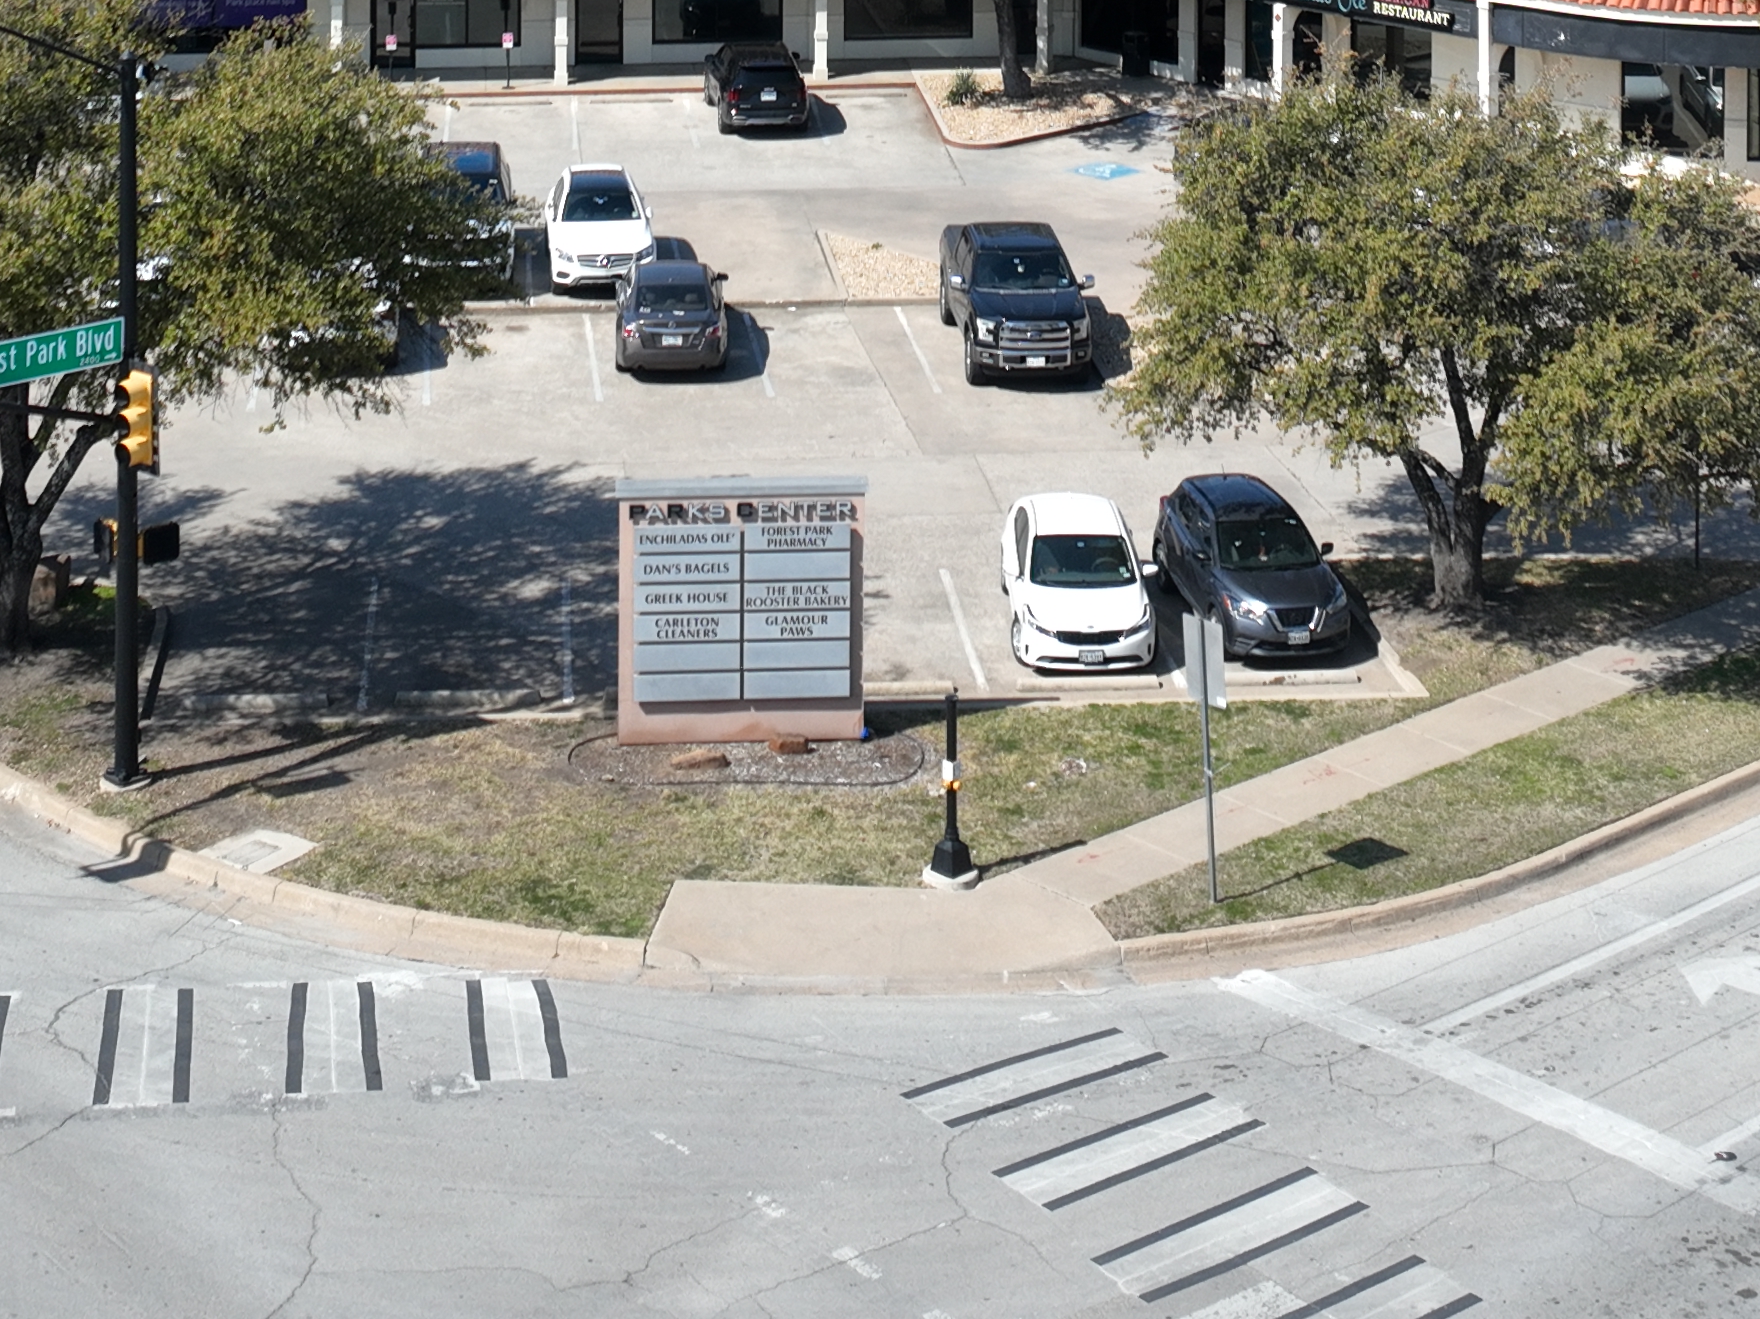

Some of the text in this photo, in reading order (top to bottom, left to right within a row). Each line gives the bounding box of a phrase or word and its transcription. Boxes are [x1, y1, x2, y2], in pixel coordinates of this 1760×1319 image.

[1372, 1, 1451, 27] RESTAURANT
[25, 335, 67, 368] Park
[75, 324, 115, 357] Blvd
[628, 499, 854, 521] PARKS CENTER
[761, 525, 834, 537] FOREST PARK
[638, 533, 708, 546] ENCHILADAS
[766, 537, 828, 549] PHARMACY
[643, 562, 730, 576] DAN'S BAGELS
[764, 584, 830, 596] THE BLACK
[644, 592, 729, 605] GREEK HOUSE
[745, 595, 849, 608] ROOSTER BAKERY
[655, 616, 720, 629] CARLETON
[764, 614, 829, 627] GLAMOUR
[656, 628, 719, 639] CLEANERS
[780, 626, 814, 637] PAWS
